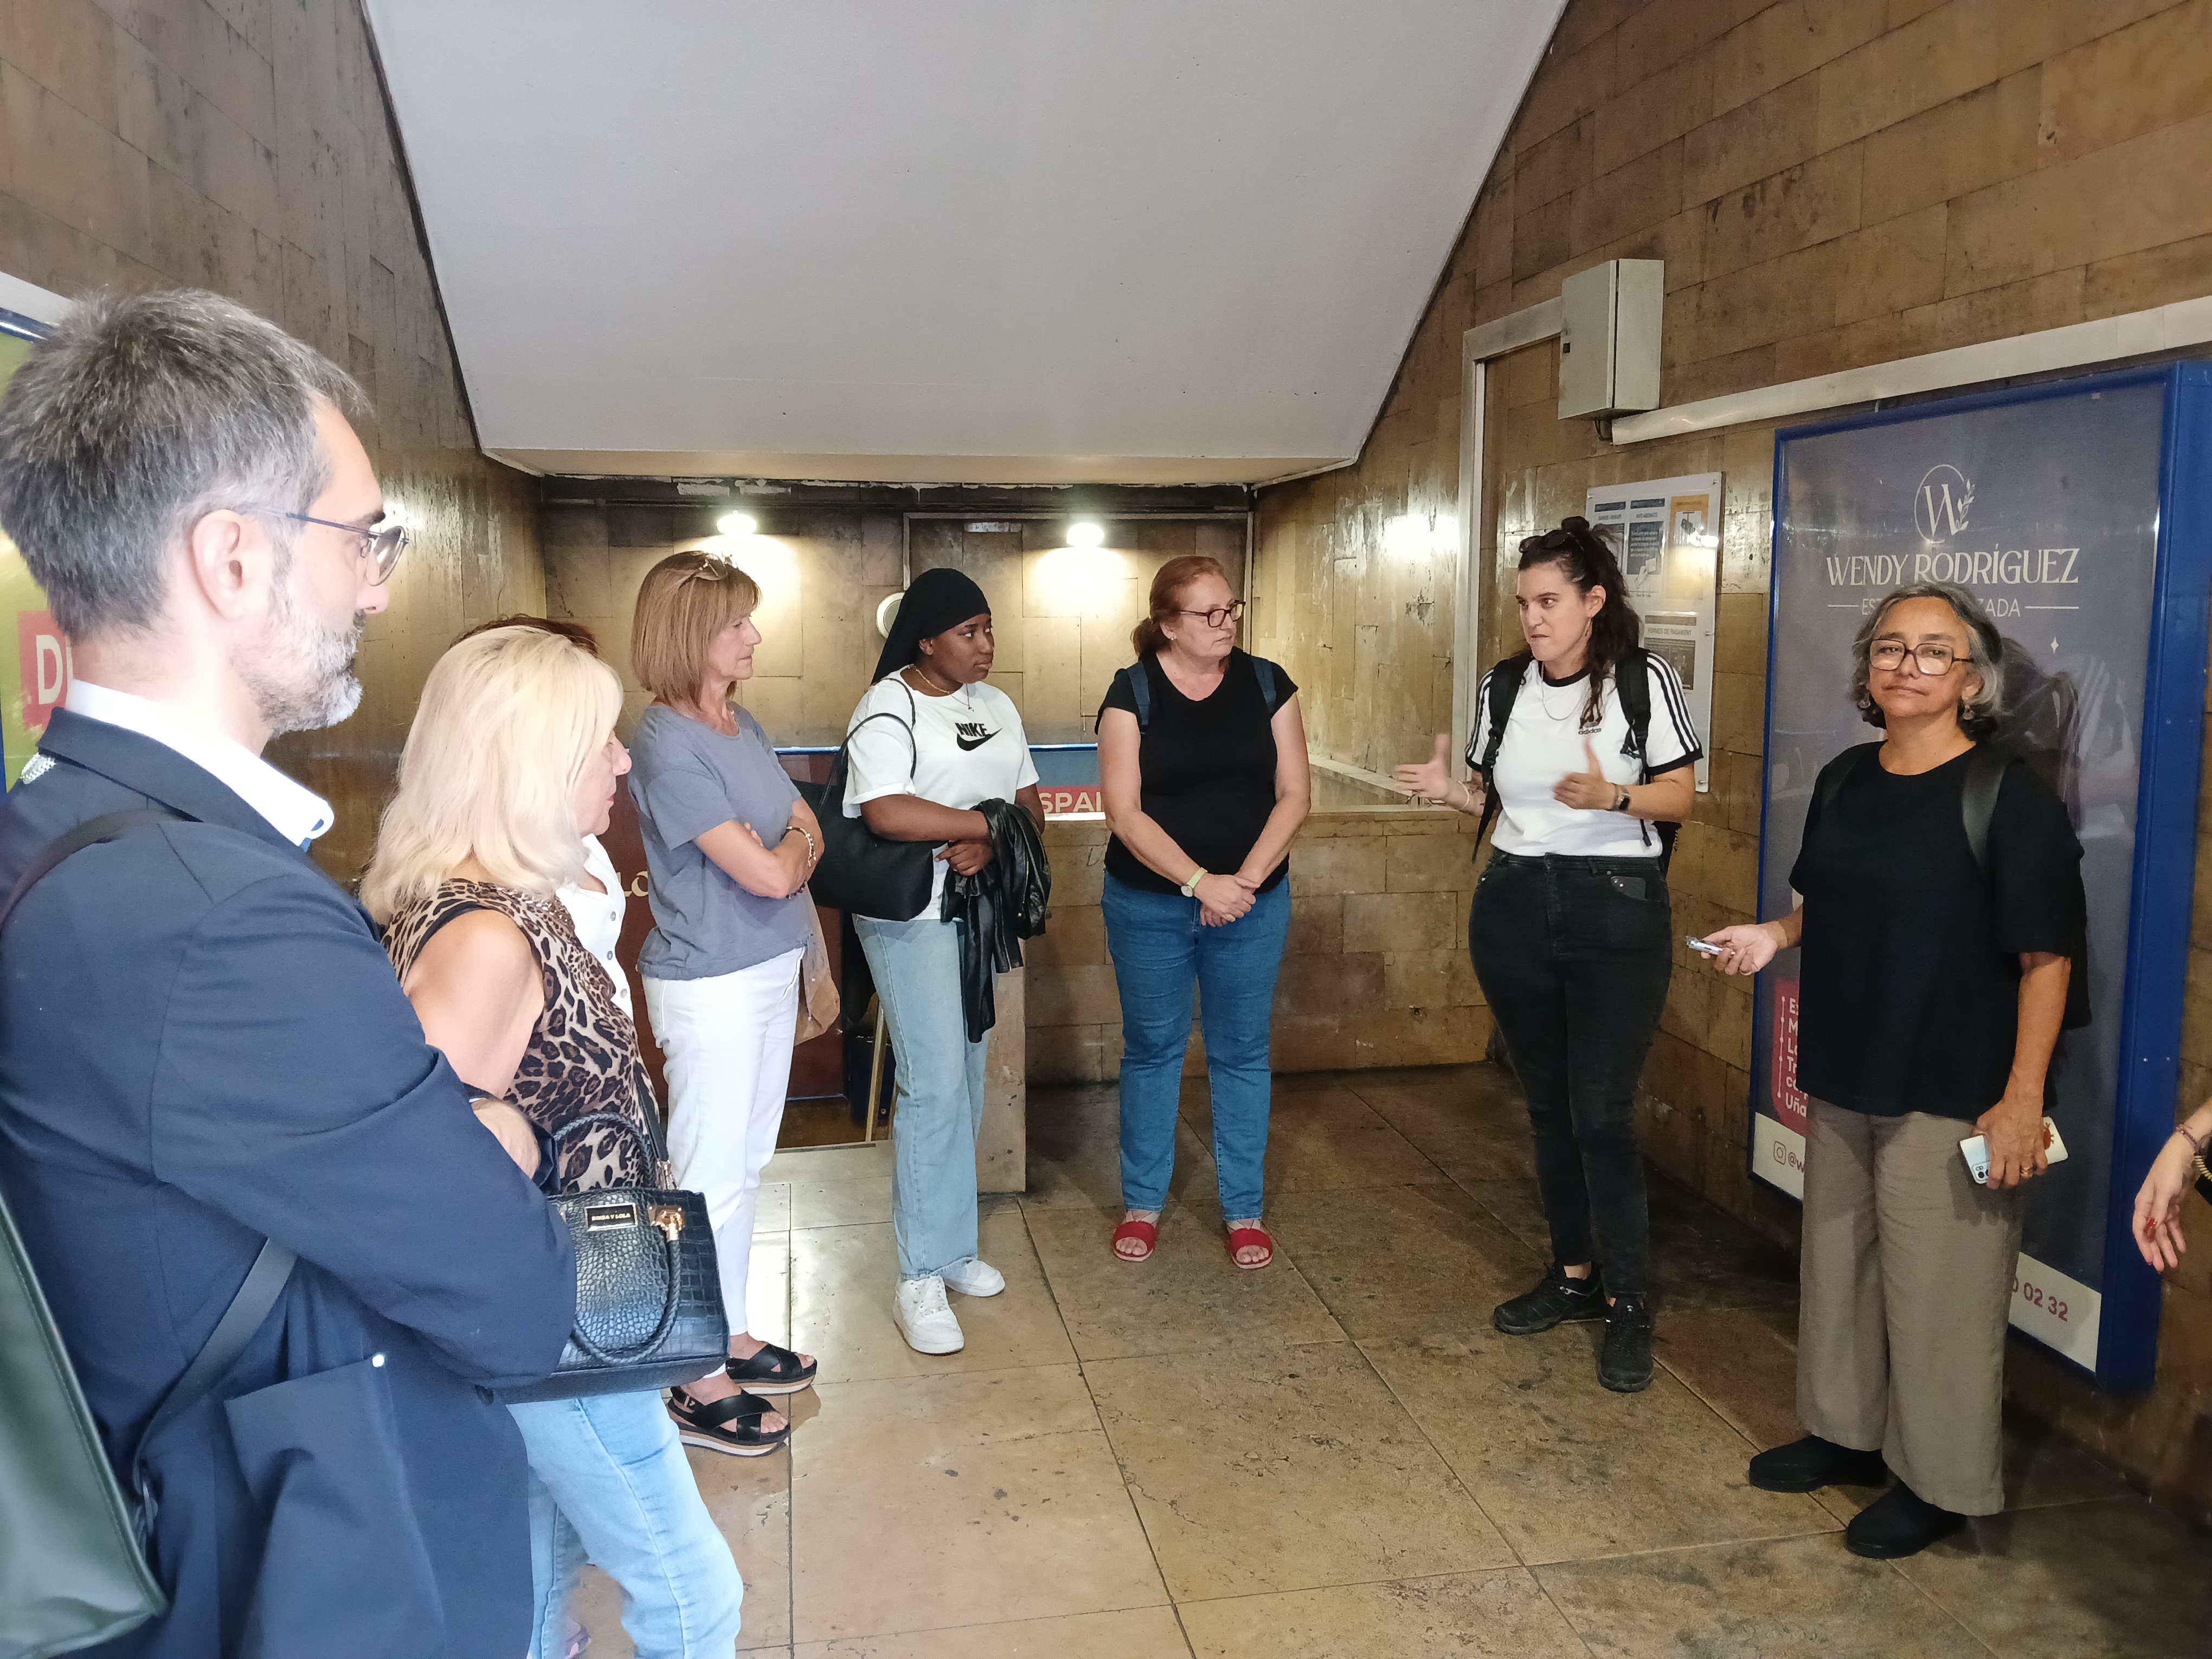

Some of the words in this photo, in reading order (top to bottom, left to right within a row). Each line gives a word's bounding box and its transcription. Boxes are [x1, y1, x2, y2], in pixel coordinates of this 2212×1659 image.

[1826, 554, 1909, 586] WENDY
[1914, 543, 2080, 586] RODRÍGUEZ
[955, 722, 987, 737] NIKE
[2023, 1282, 2043, 1308] 02
[2048, 1296, 2068, 1322] 32
